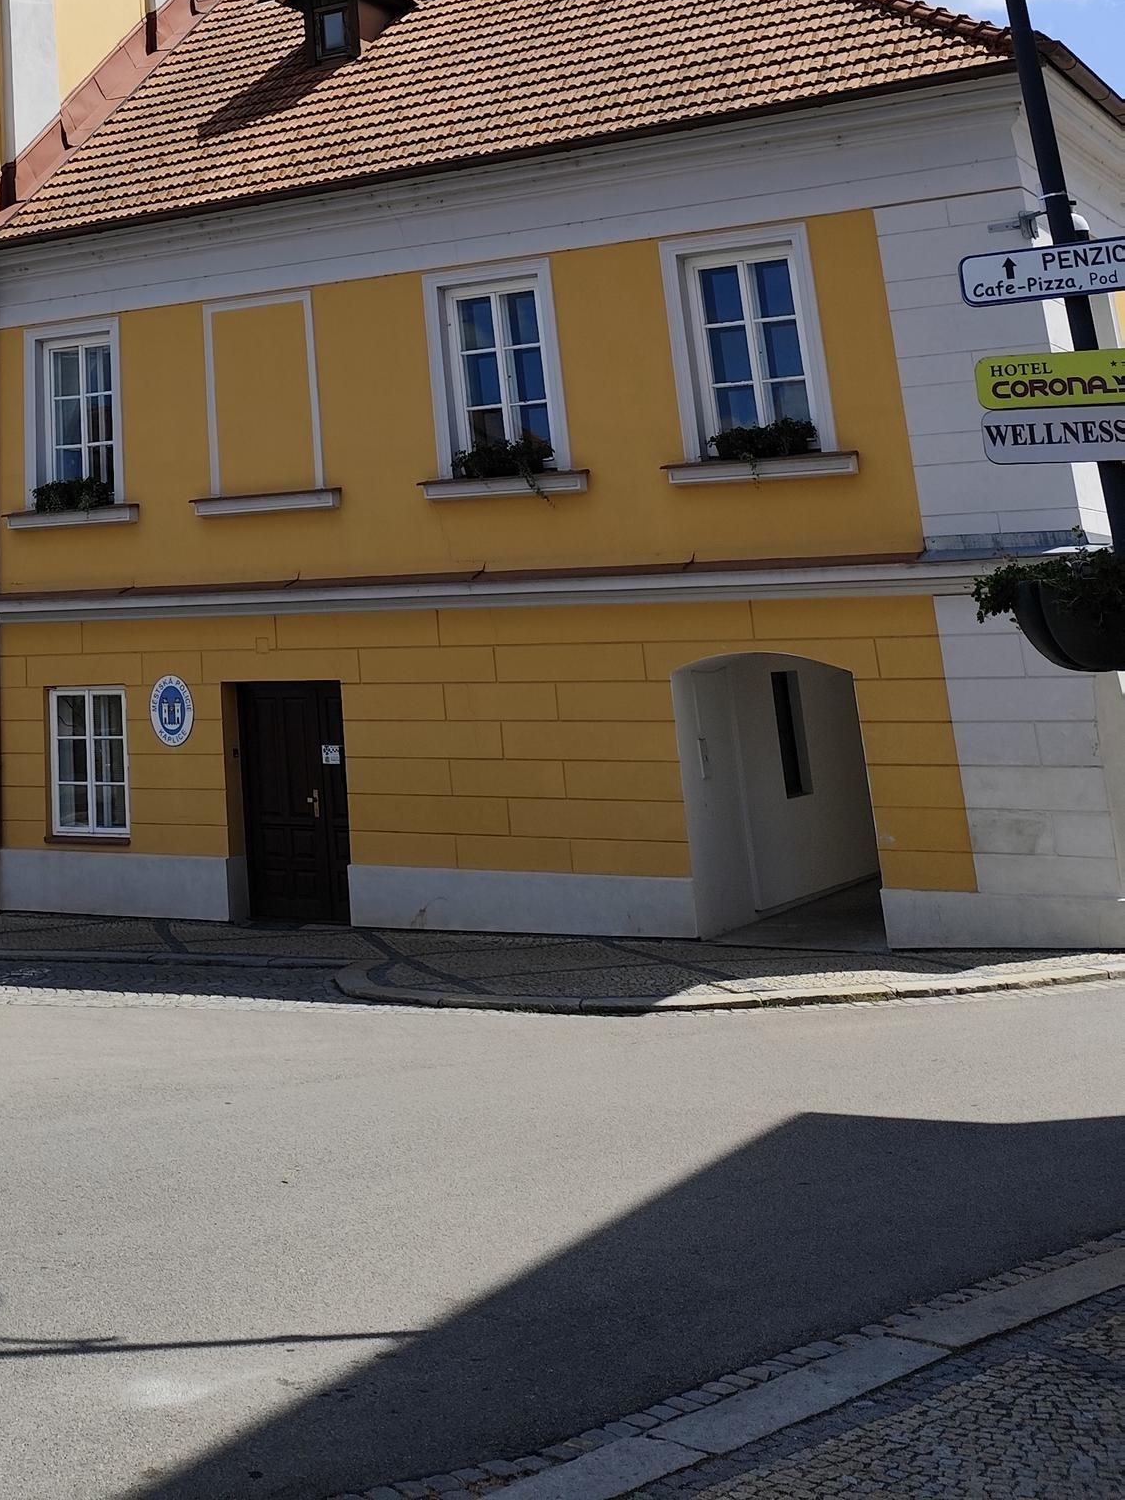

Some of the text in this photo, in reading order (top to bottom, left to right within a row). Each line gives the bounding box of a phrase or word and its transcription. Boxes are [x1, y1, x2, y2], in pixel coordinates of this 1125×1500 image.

[973, 270, 1118, 298] Cafe-Pizza, Pod
[990, 362, 1053, 378] HOTEL
[992, 376, 1117, 399] CORONA
[175, 679, 192, 711] POLICIE
[158, 729, 187, 743] KAPLICE
